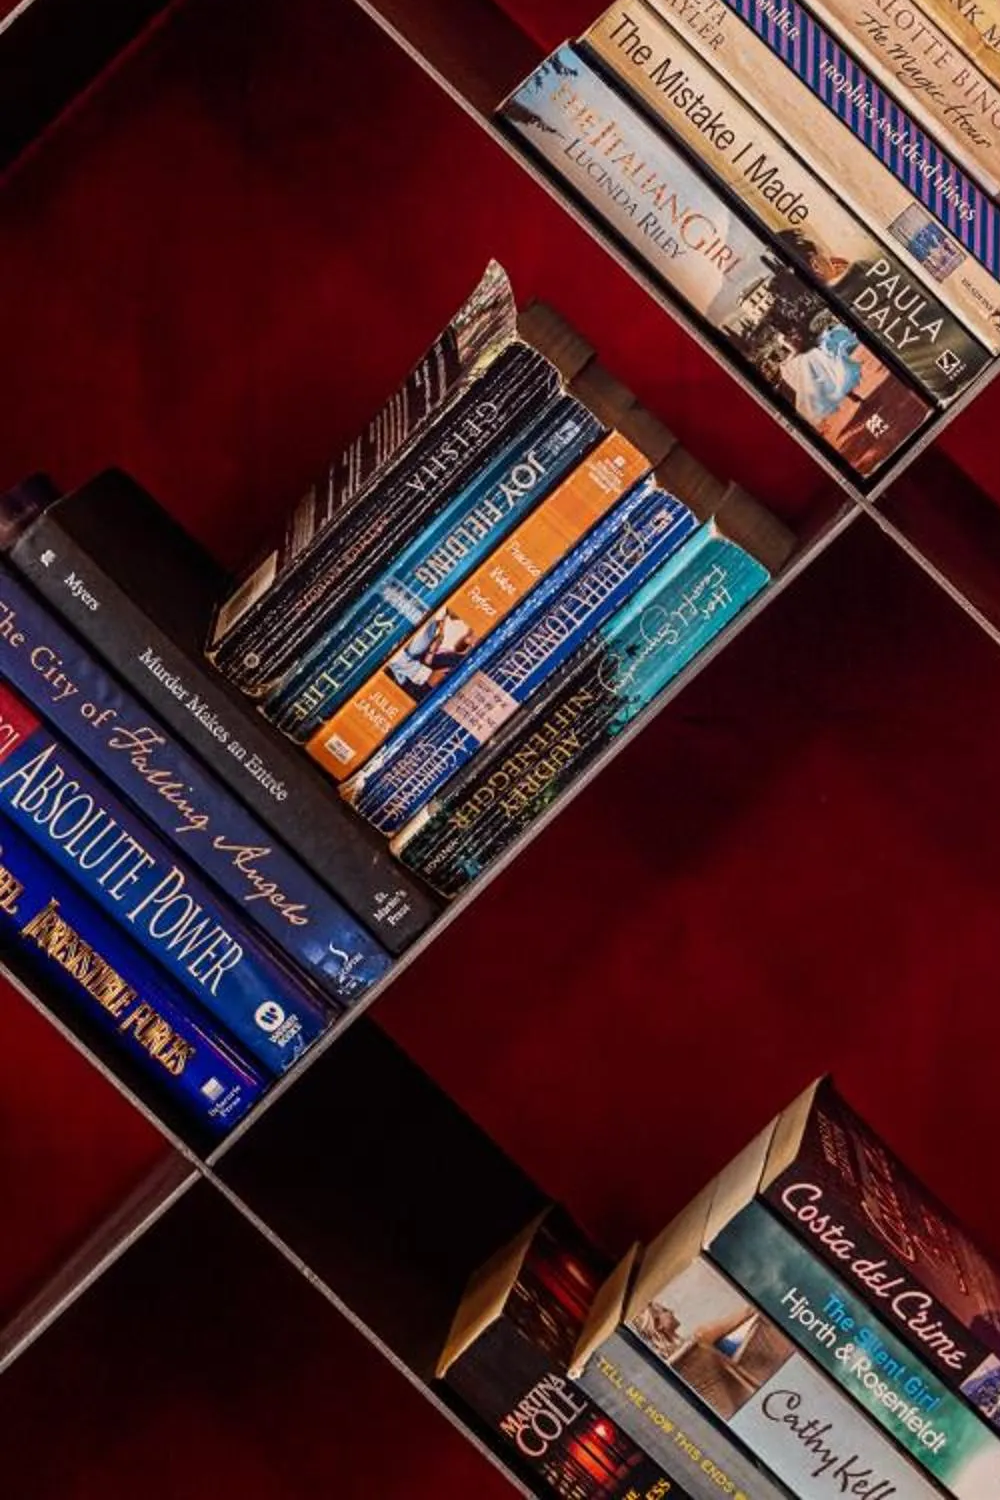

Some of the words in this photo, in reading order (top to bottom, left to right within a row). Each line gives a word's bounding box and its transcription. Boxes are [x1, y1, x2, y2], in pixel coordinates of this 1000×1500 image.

[607, 13, 654, 66] The
[649, 59, 737, 150] Mistake
[730, 143, 753, 164] I
[743, 154, 811, 226] Made
[563, 138, 639, 217] LUCINDA
[636, 211, 684, 260] RILEY
[853, 287, 919, 350] DALY
[865, 259, 945, 342] PAULA
[496, 451, 547, 507] JOY
[415, 499, 503, 588] FIELDING
[61, 572, 102, 612] Myers
[333, 612, 393, 671] STILL
[137, 648, 191, 701] Murder
[185, 695, 230, 743] Makes
[226, 740, 246, 760] an
[244, 754, 289, 801] Entrée
[289, 670, 337, 719] LIFE
[449, 686, 592, 830] NIFFENEGGER
[498, 728, 581, 817] AUDREY
[0, 744, 157, 901] ABSOLUTE
[127, 866, 249, 994] POWER
[781, 1182, 855, 1258] Costa
[851, 1258, 900, 1296] del
[891, 1290, 966, 1368] Crime
[779, 1287, 837, 1348] Hjorth
[832, 1340, 853, 1363] &
[851, 1360, 948, 1454] Rosenfeldt
[819, 1295, 858, 1332] The
[852, 1326, 907, 1380] Silent
[903, 1375, 940, 1412] Girl
[499, 1372, 565, 1437] MARTINA
[514, 1384, 587, 1458] COLE
[594, 1358, 625, 1387] TELL
[624, 1386, 647, 1408] ME
[643, 1405, 673, 1435] HOW
[671, 1433, 701, 1462] THIS
[699, 1459, 734, 1493] ENDS
[760, 1389, 838, 1476] Cathy
